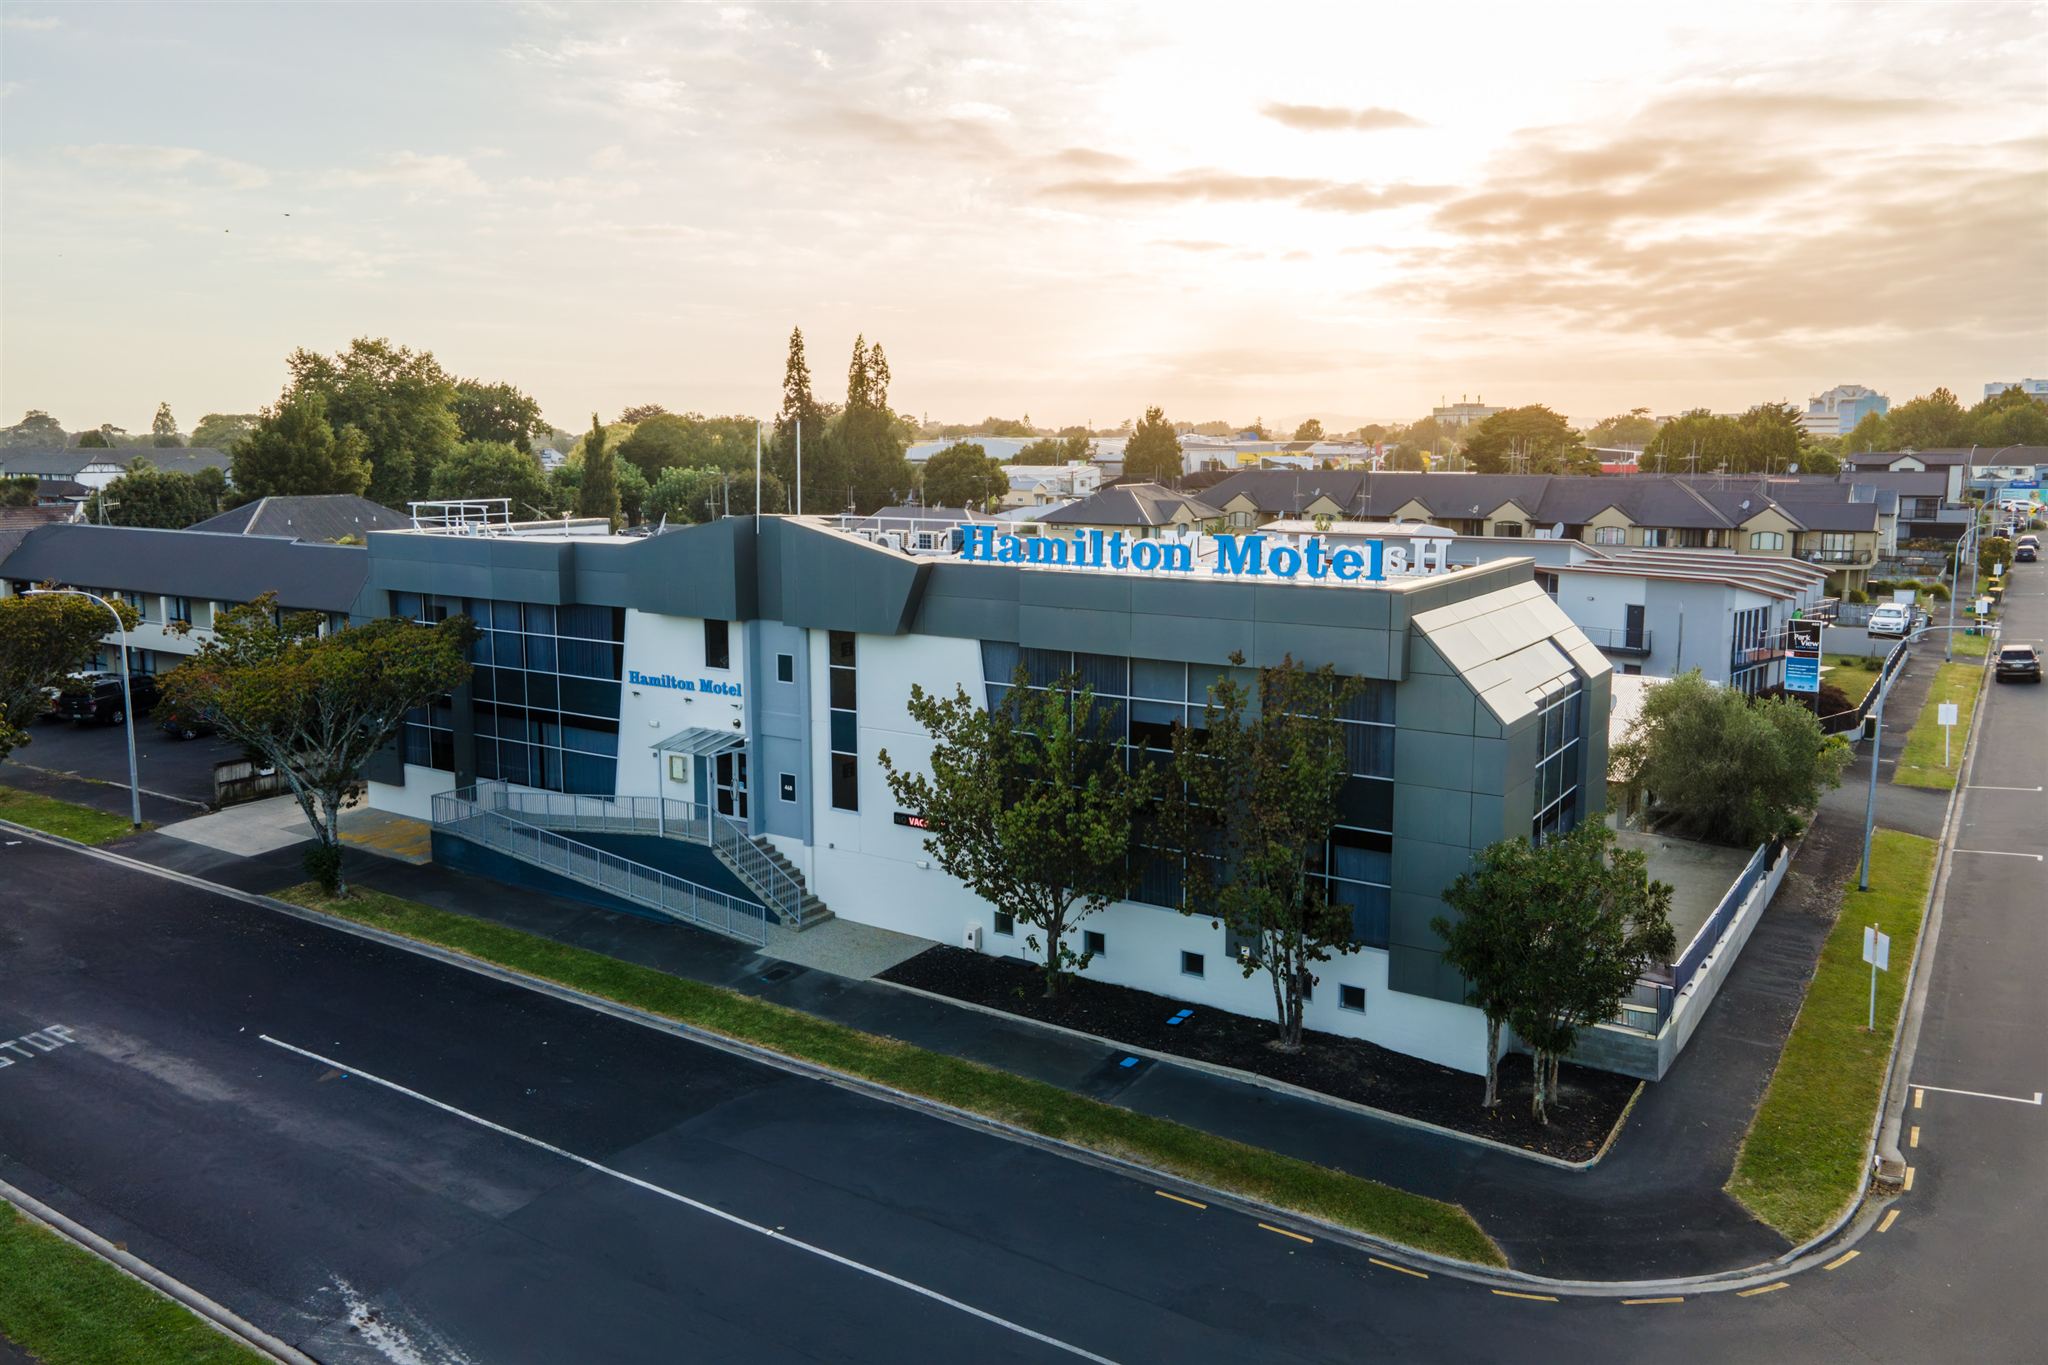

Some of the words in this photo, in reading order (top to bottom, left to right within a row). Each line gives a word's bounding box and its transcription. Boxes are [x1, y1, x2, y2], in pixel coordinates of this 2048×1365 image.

[960, 524, 1195, 571] Hamilton
[1212, 534, 1387, 581] Motel
[628, 670, 695, 691] Hamilton
[699, 678, 742, 697] Motel
